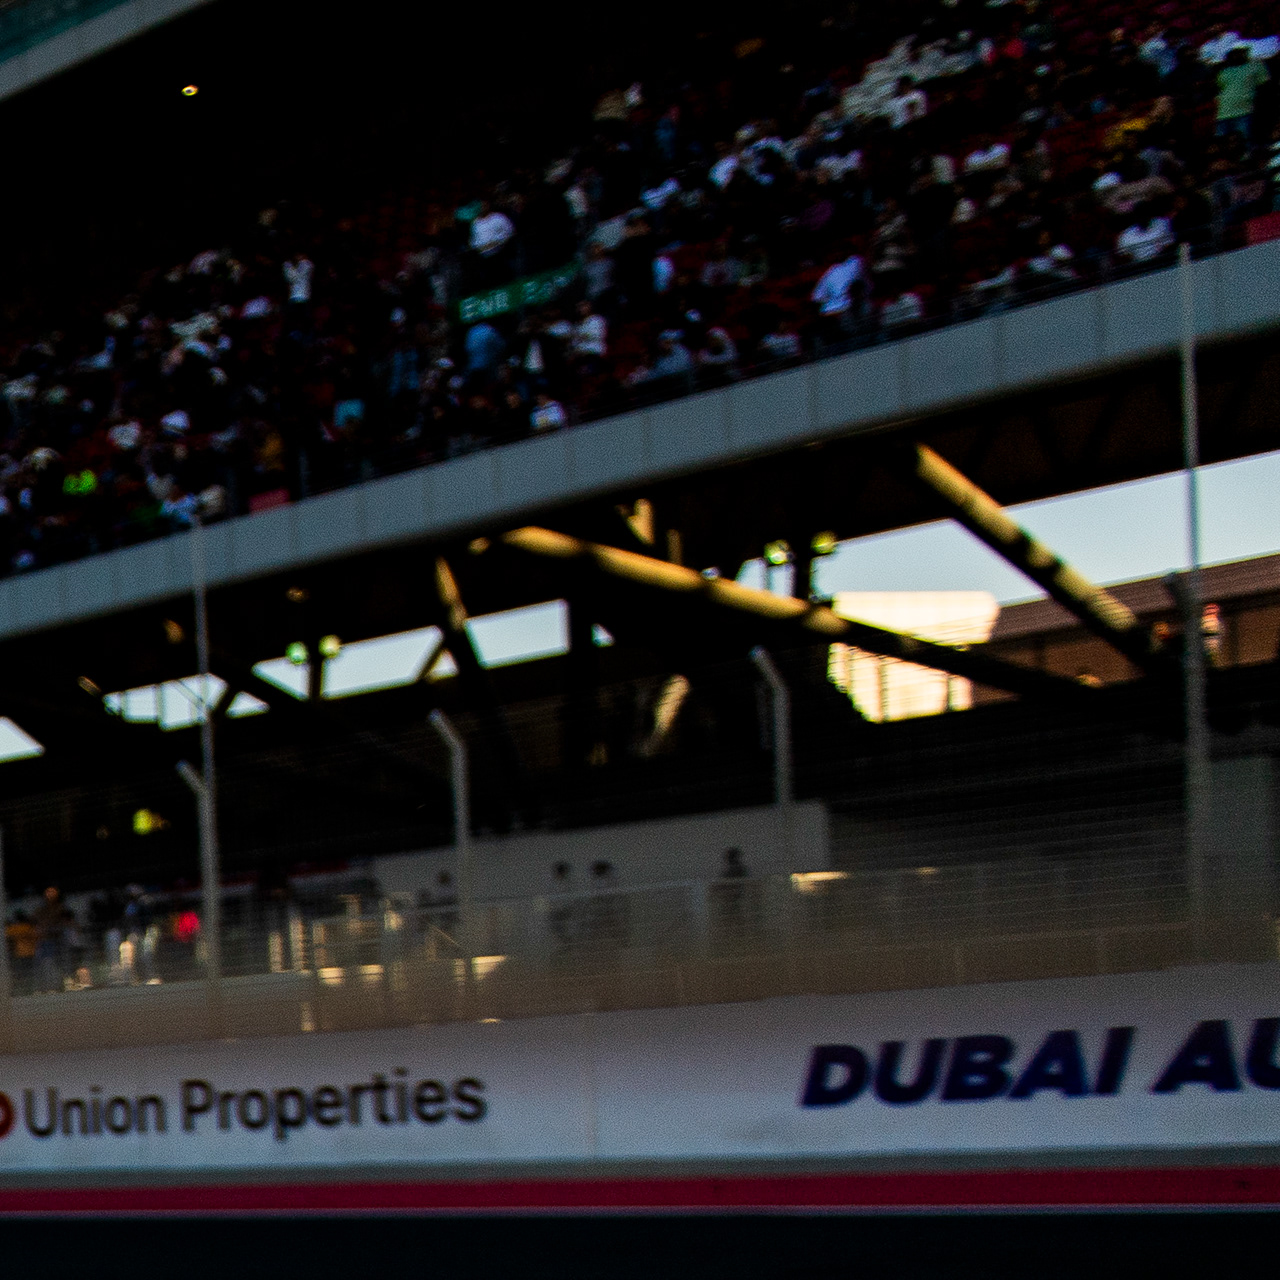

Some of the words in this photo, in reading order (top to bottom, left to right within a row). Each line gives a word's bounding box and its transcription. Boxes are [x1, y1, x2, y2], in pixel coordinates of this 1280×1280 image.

[22, 1085, 168, 1138] Union
[181, 1065, 488, 1141] Properties
[797, 1026, 1137, 1110] DUBAI
